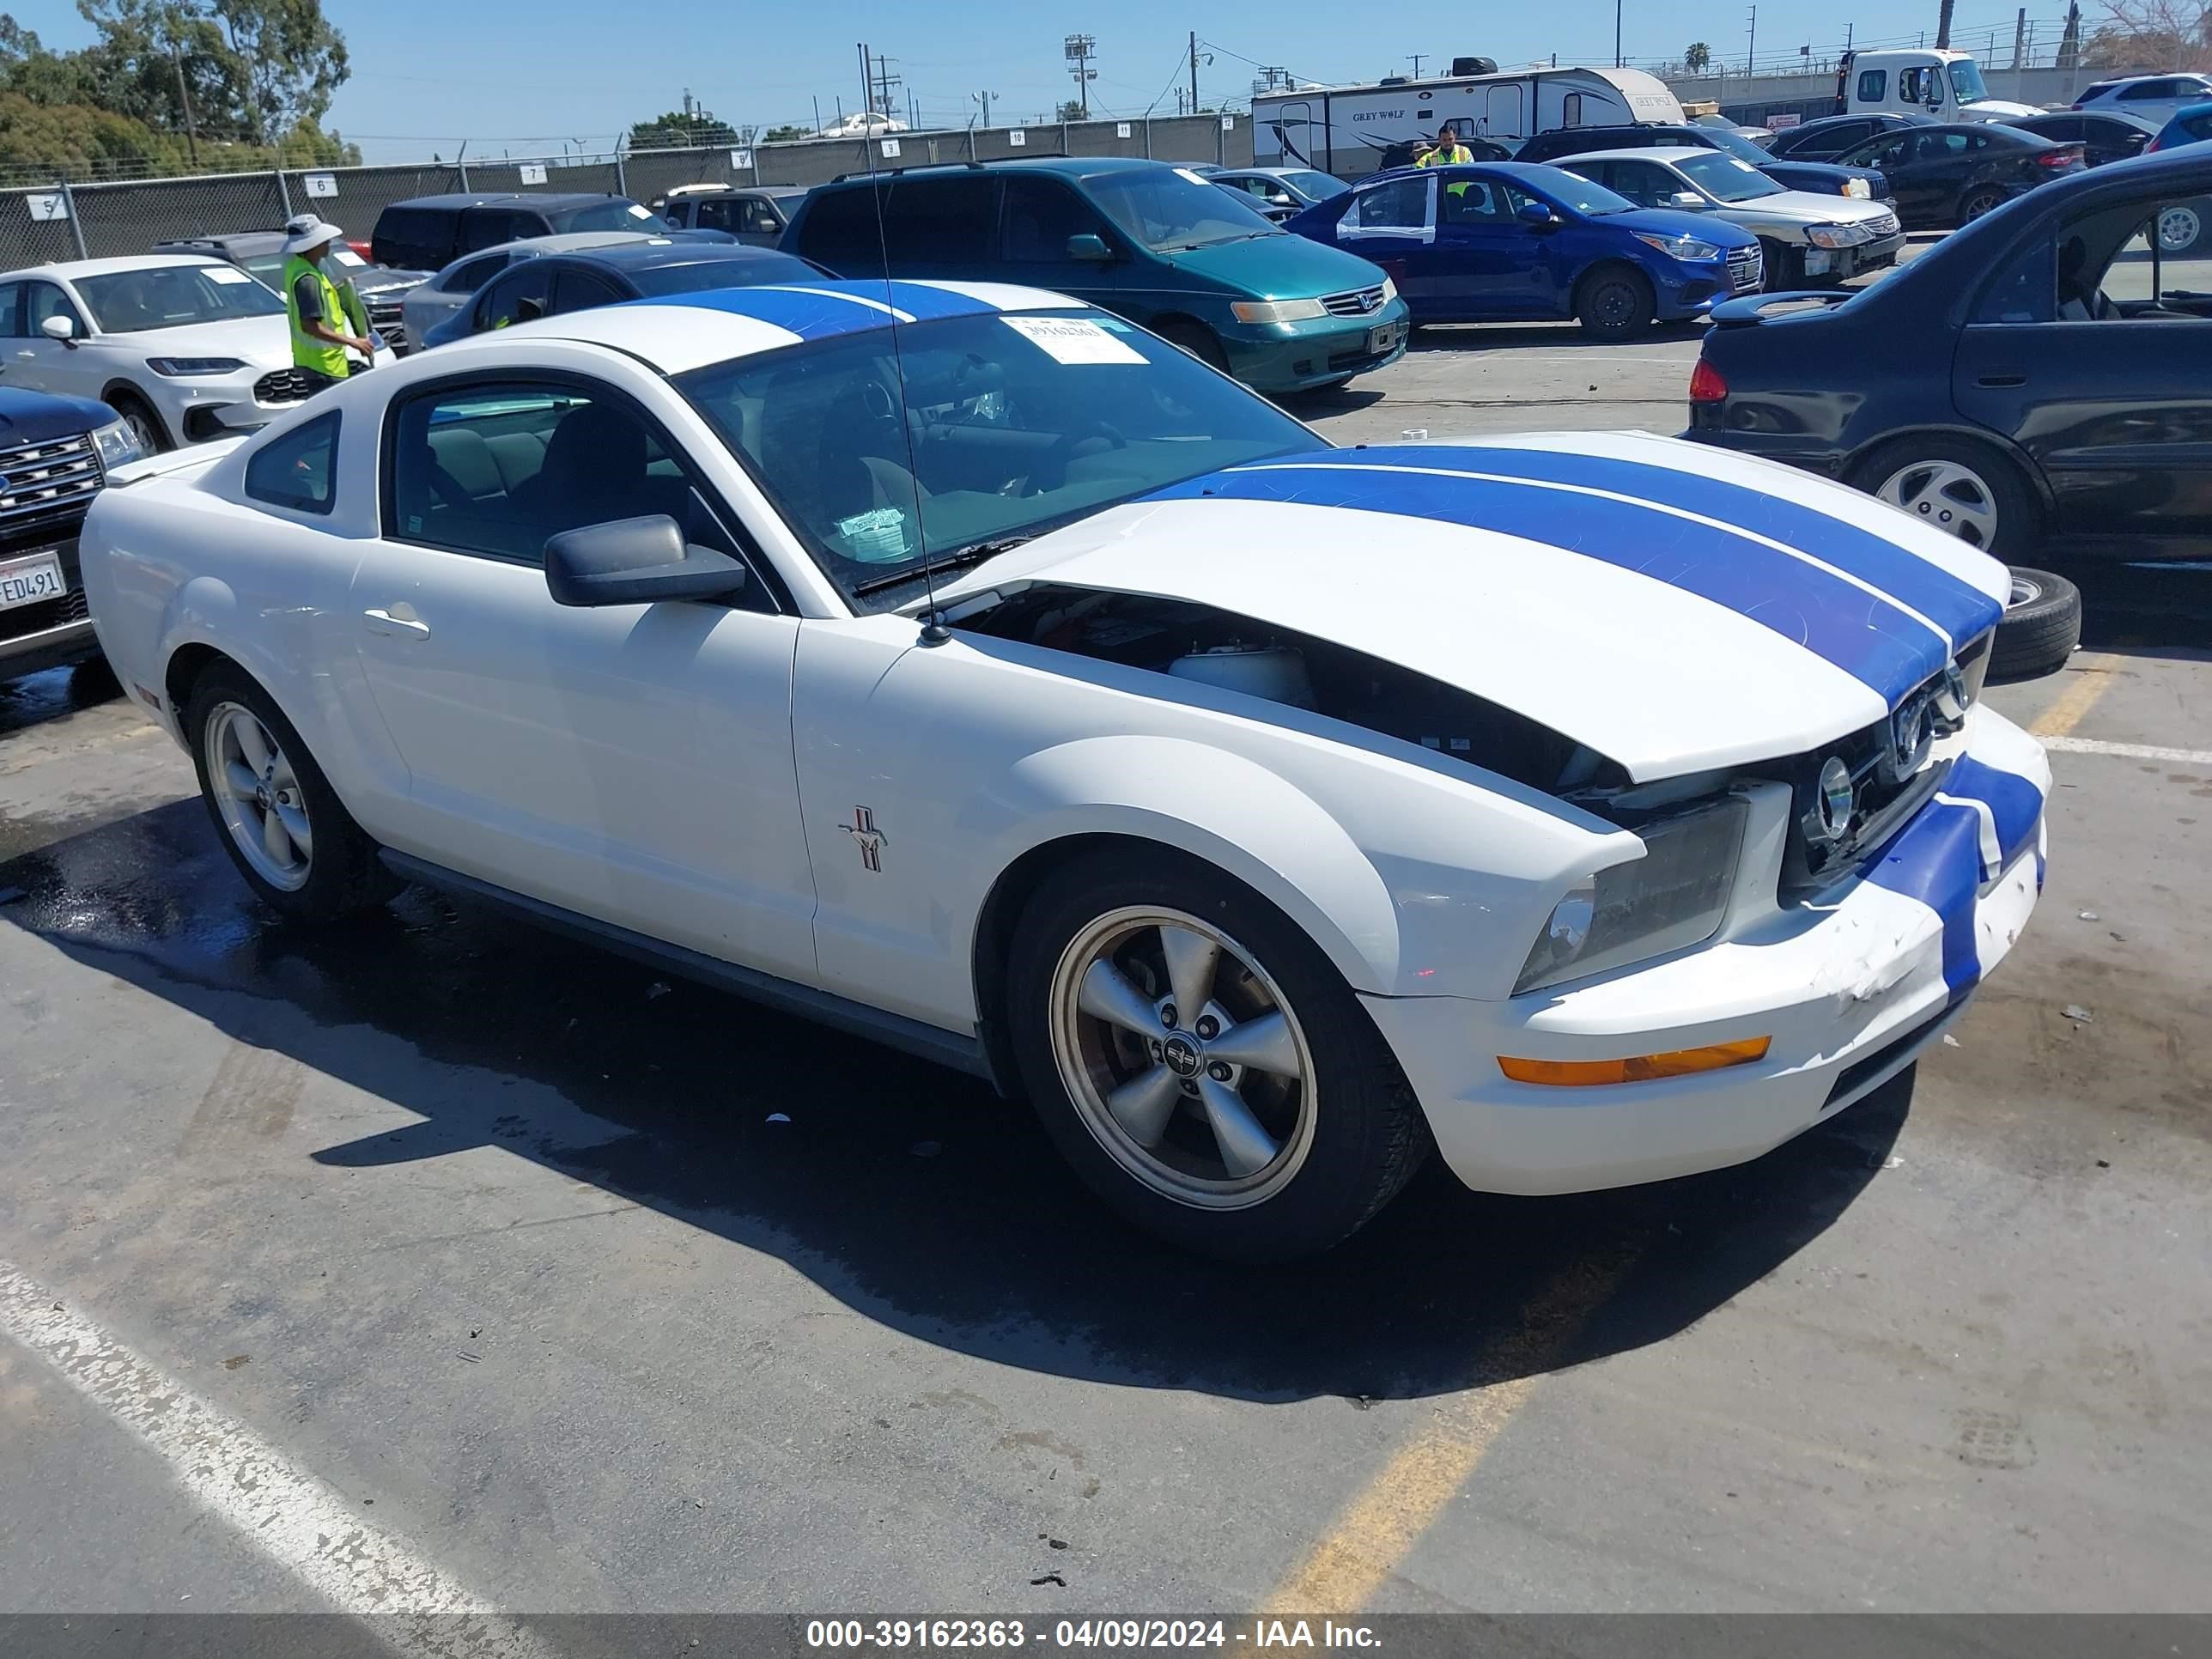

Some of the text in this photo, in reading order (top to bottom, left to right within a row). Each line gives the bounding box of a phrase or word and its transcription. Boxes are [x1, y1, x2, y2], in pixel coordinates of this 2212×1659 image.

[1352, 110, 1405, 122] GREY WOLF
[1014, 133, 1022, 142] 10
[888, 143, 894, 154] 9
[531, 168, 537, 179] 7
[318, 180, 325, 192] 6
[43, 200, 53, 214] 5
[1024, 326, 1100, 337] 39162363
[0, 571, 58, 601] ED491
